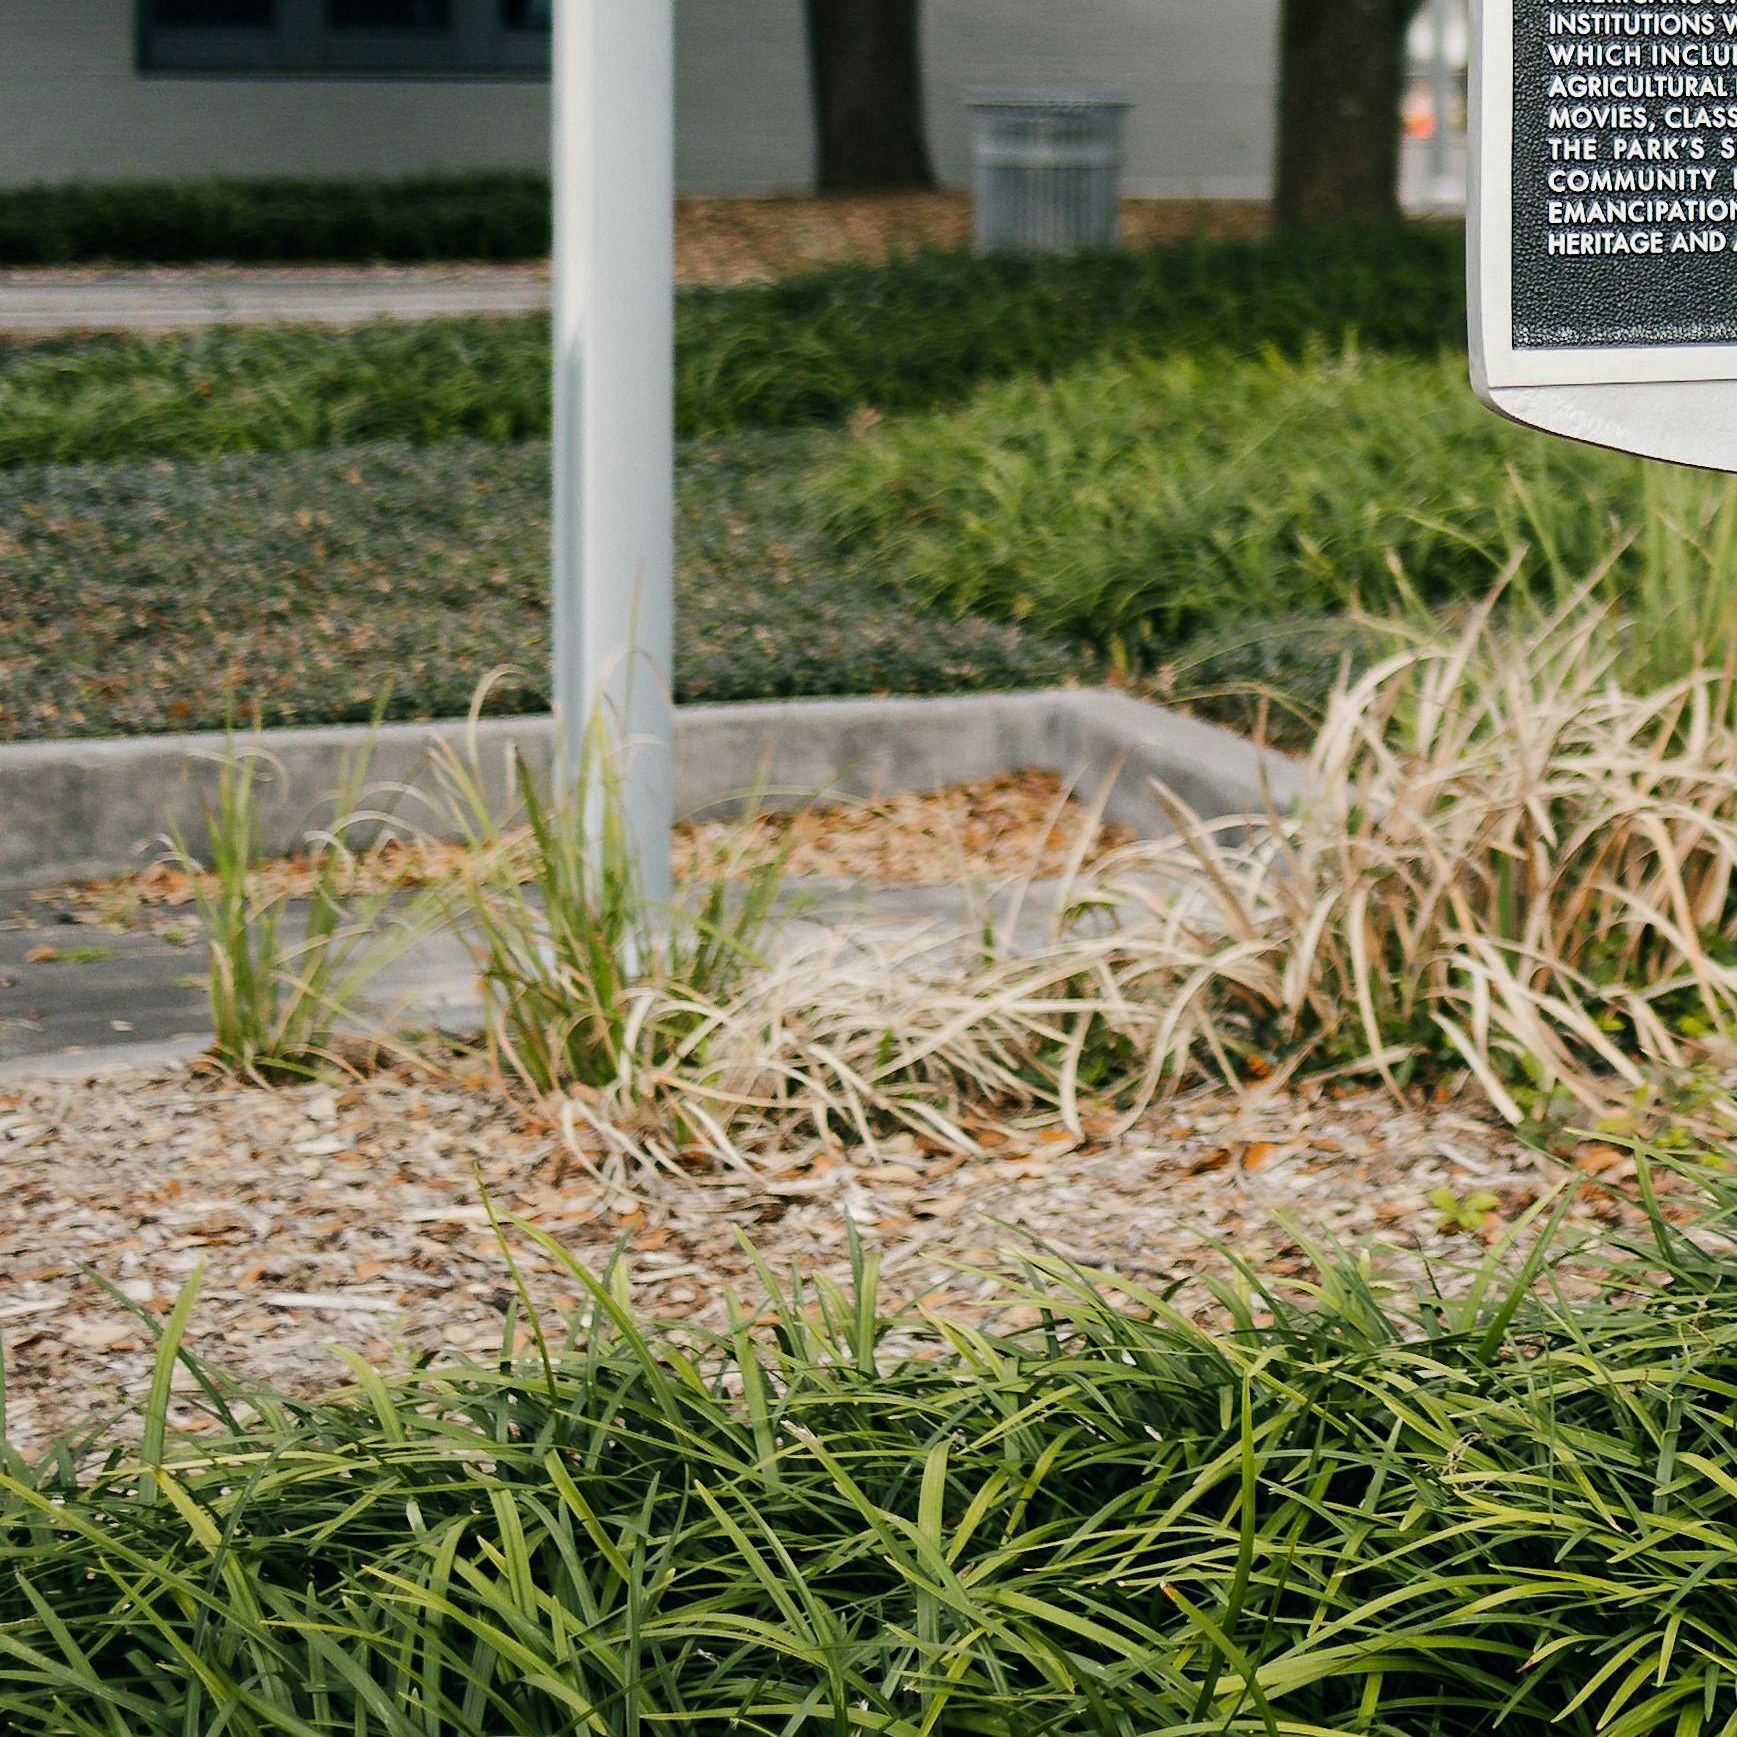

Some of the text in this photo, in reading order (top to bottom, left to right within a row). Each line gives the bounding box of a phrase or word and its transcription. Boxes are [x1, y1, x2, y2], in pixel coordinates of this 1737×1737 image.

[1549, 12, 1715, 35] INSTITUTIONS
[1548, 74, 1728, 98] AGRICULTURAL
[1545, 137, 1597, 160] THE
